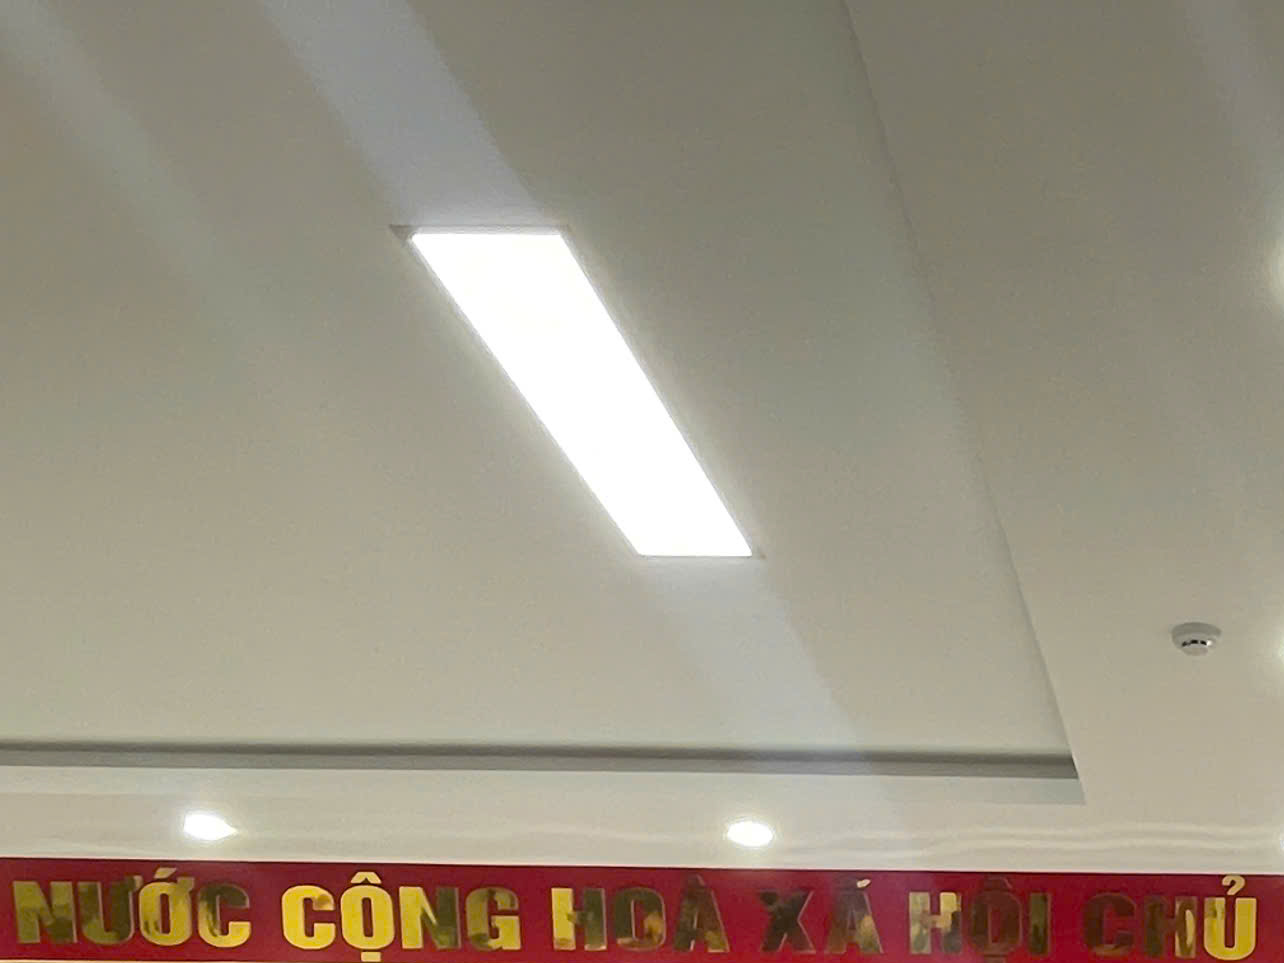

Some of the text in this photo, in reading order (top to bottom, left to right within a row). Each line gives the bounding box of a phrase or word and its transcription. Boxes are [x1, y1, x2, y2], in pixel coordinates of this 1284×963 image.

[12, 867, 251, 948] NƯỚC
[281, 871, 521, 962] CỘNG
[1083, 875, 1257, 961] CHỦ
